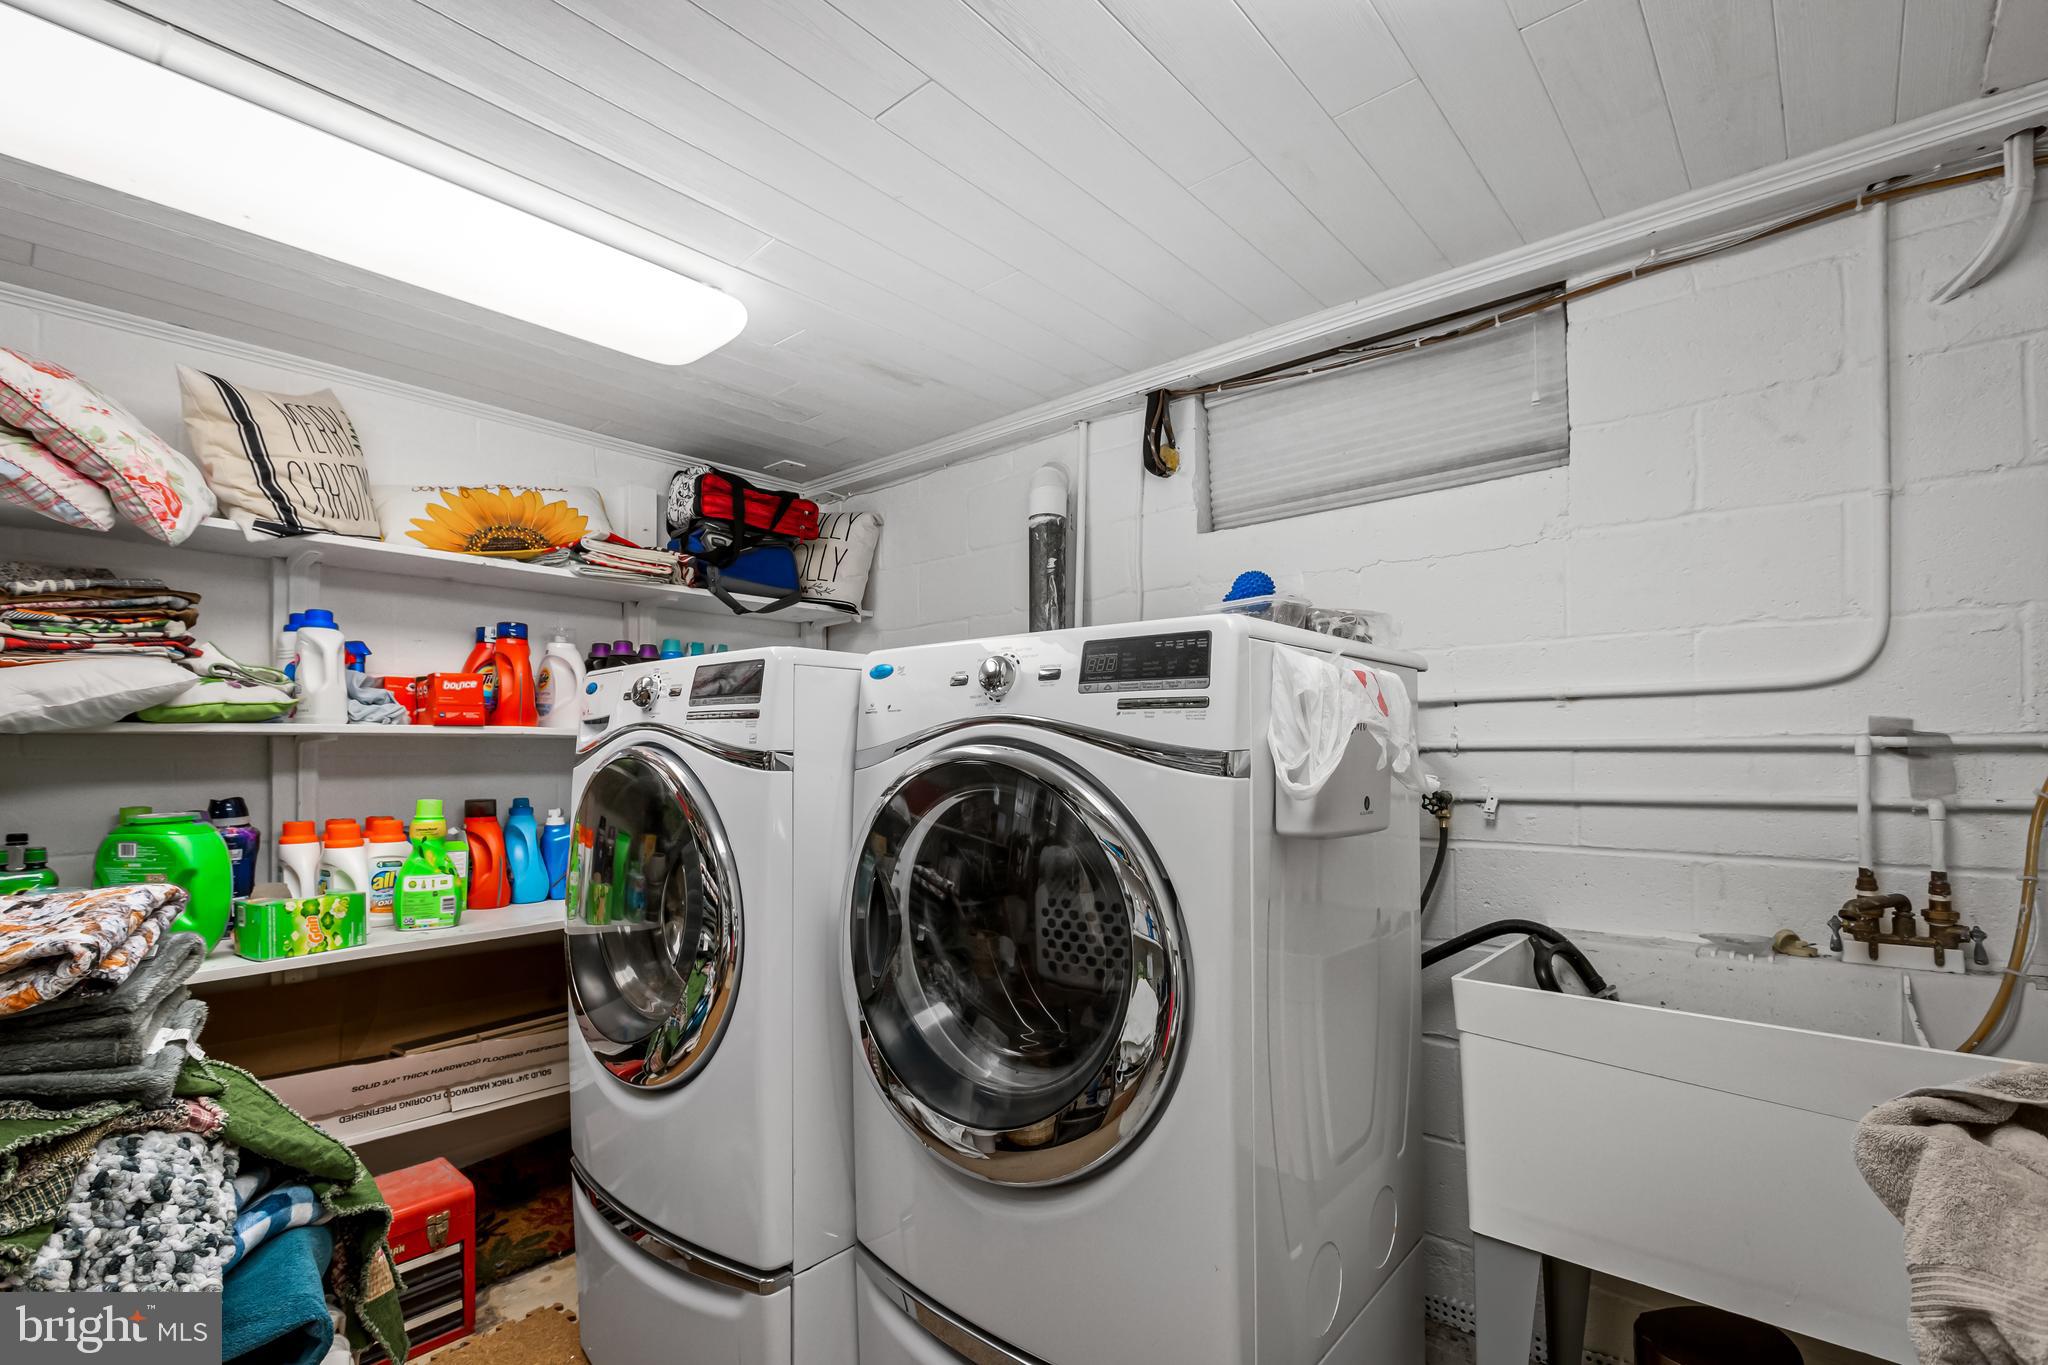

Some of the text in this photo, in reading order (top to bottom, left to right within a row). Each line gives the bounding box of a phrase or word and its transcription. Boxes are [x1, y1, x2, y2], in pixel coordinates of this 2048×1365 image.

[267, 398, 364, 458] MERRY
[442, 679, 478, 691] bounce
[372, 871, 397, 893] all
[307, 915, 324, 944] Gain
[351, 1080, 381, 1093] SOLID
[402, 1070, 429, 1081] THICK
[430, 1058, 482, 1075] HARDWOOD
[482, 1050, 524, 1063] FLOORING
[530, 1068, 552, 1080] SOLID
[443, 1081, 490, 1099] HARDWOOD
[491, 1078, 514, 1090] THICK
[400, 1091, 442, 1110] FLOORING
[338, 1102, 398, 1124] PREFINISHED
